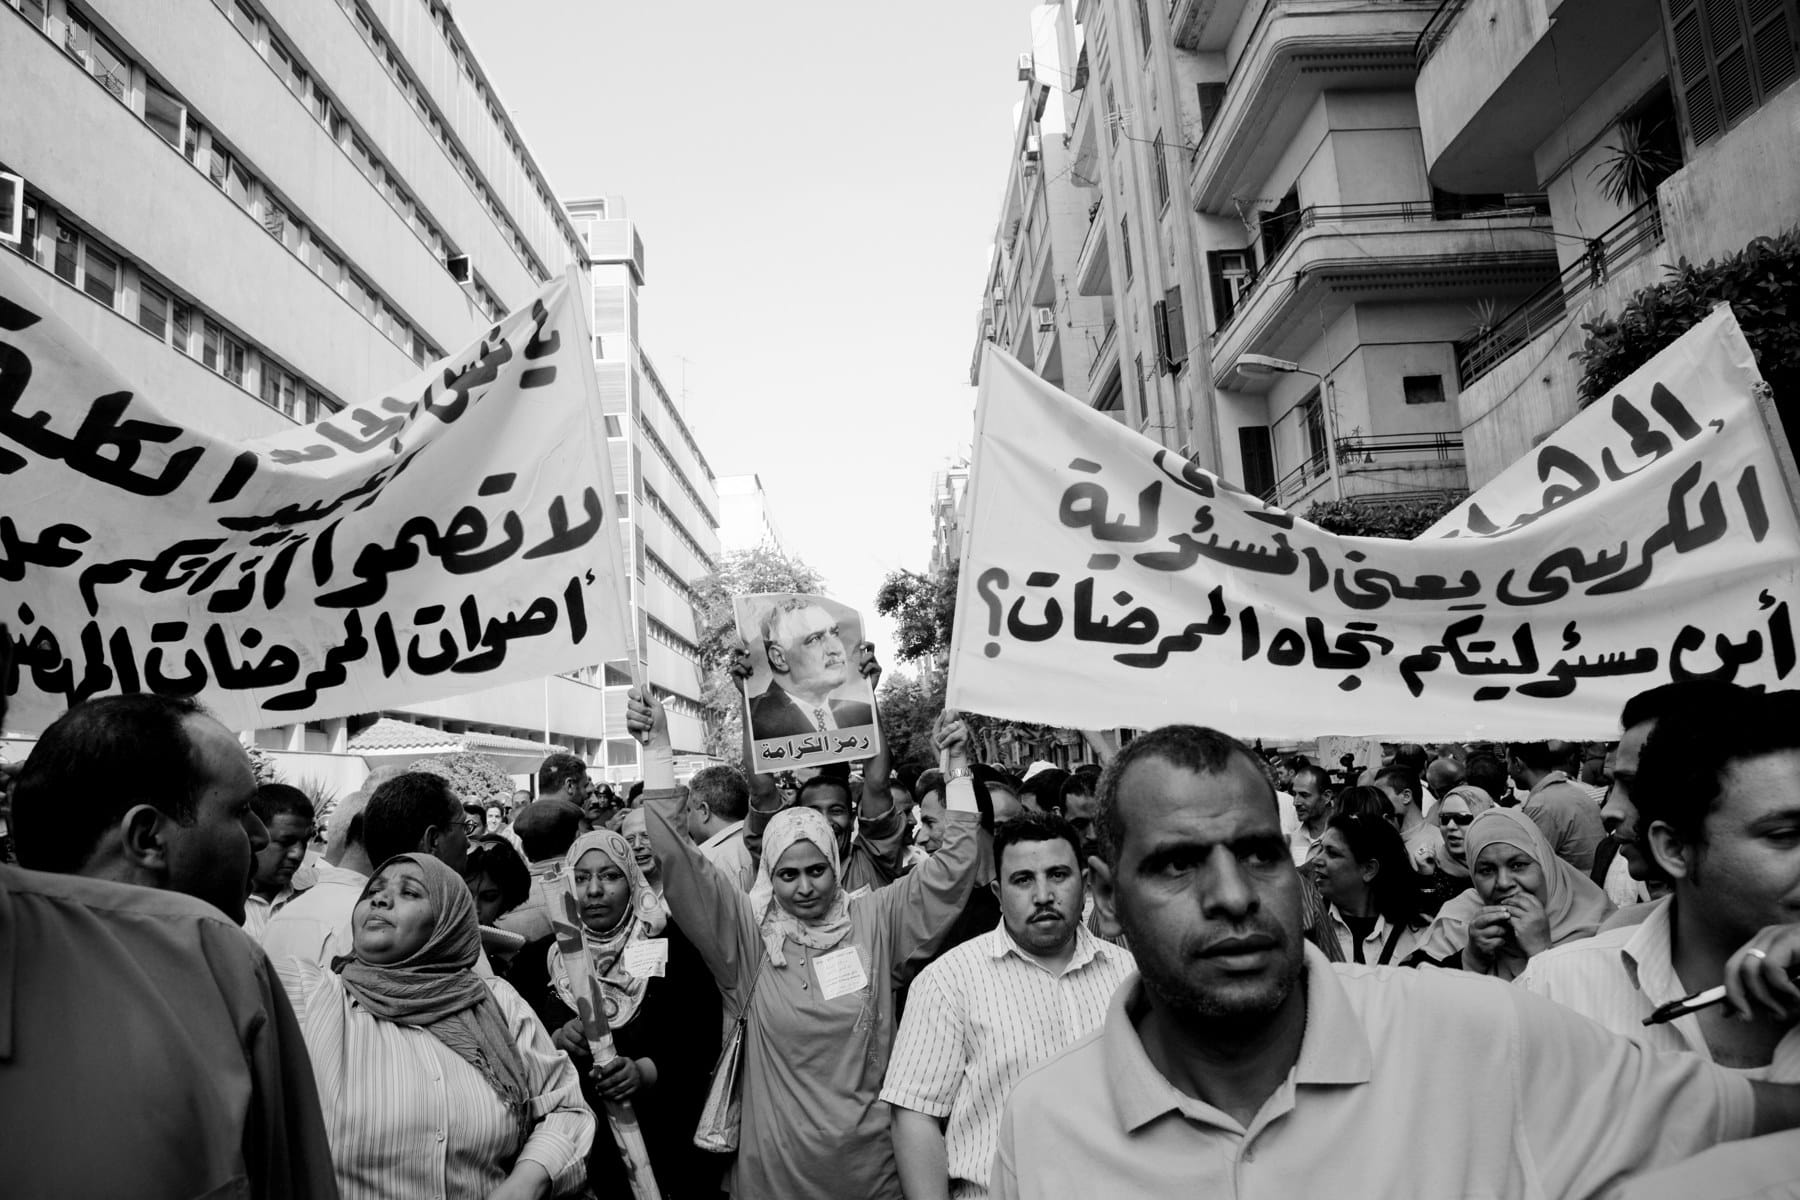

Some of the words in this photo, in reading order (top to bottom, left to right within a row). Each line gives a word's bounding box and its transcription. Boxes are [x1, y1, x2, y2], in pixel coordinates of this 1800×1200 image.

[312, 472, 524, 608] تصموا
[522, 486, 603, 560] لا
[1497, 460, 1770, 607] الكرسى
[406, 567, 596, 675] أصوات
[1266, 621, 1395, 691] تجاه
[1669, 588, 1796, 692] أين
[761, 735, 830, 760] الكرامة
[833, 735, 870, 754] رمز
